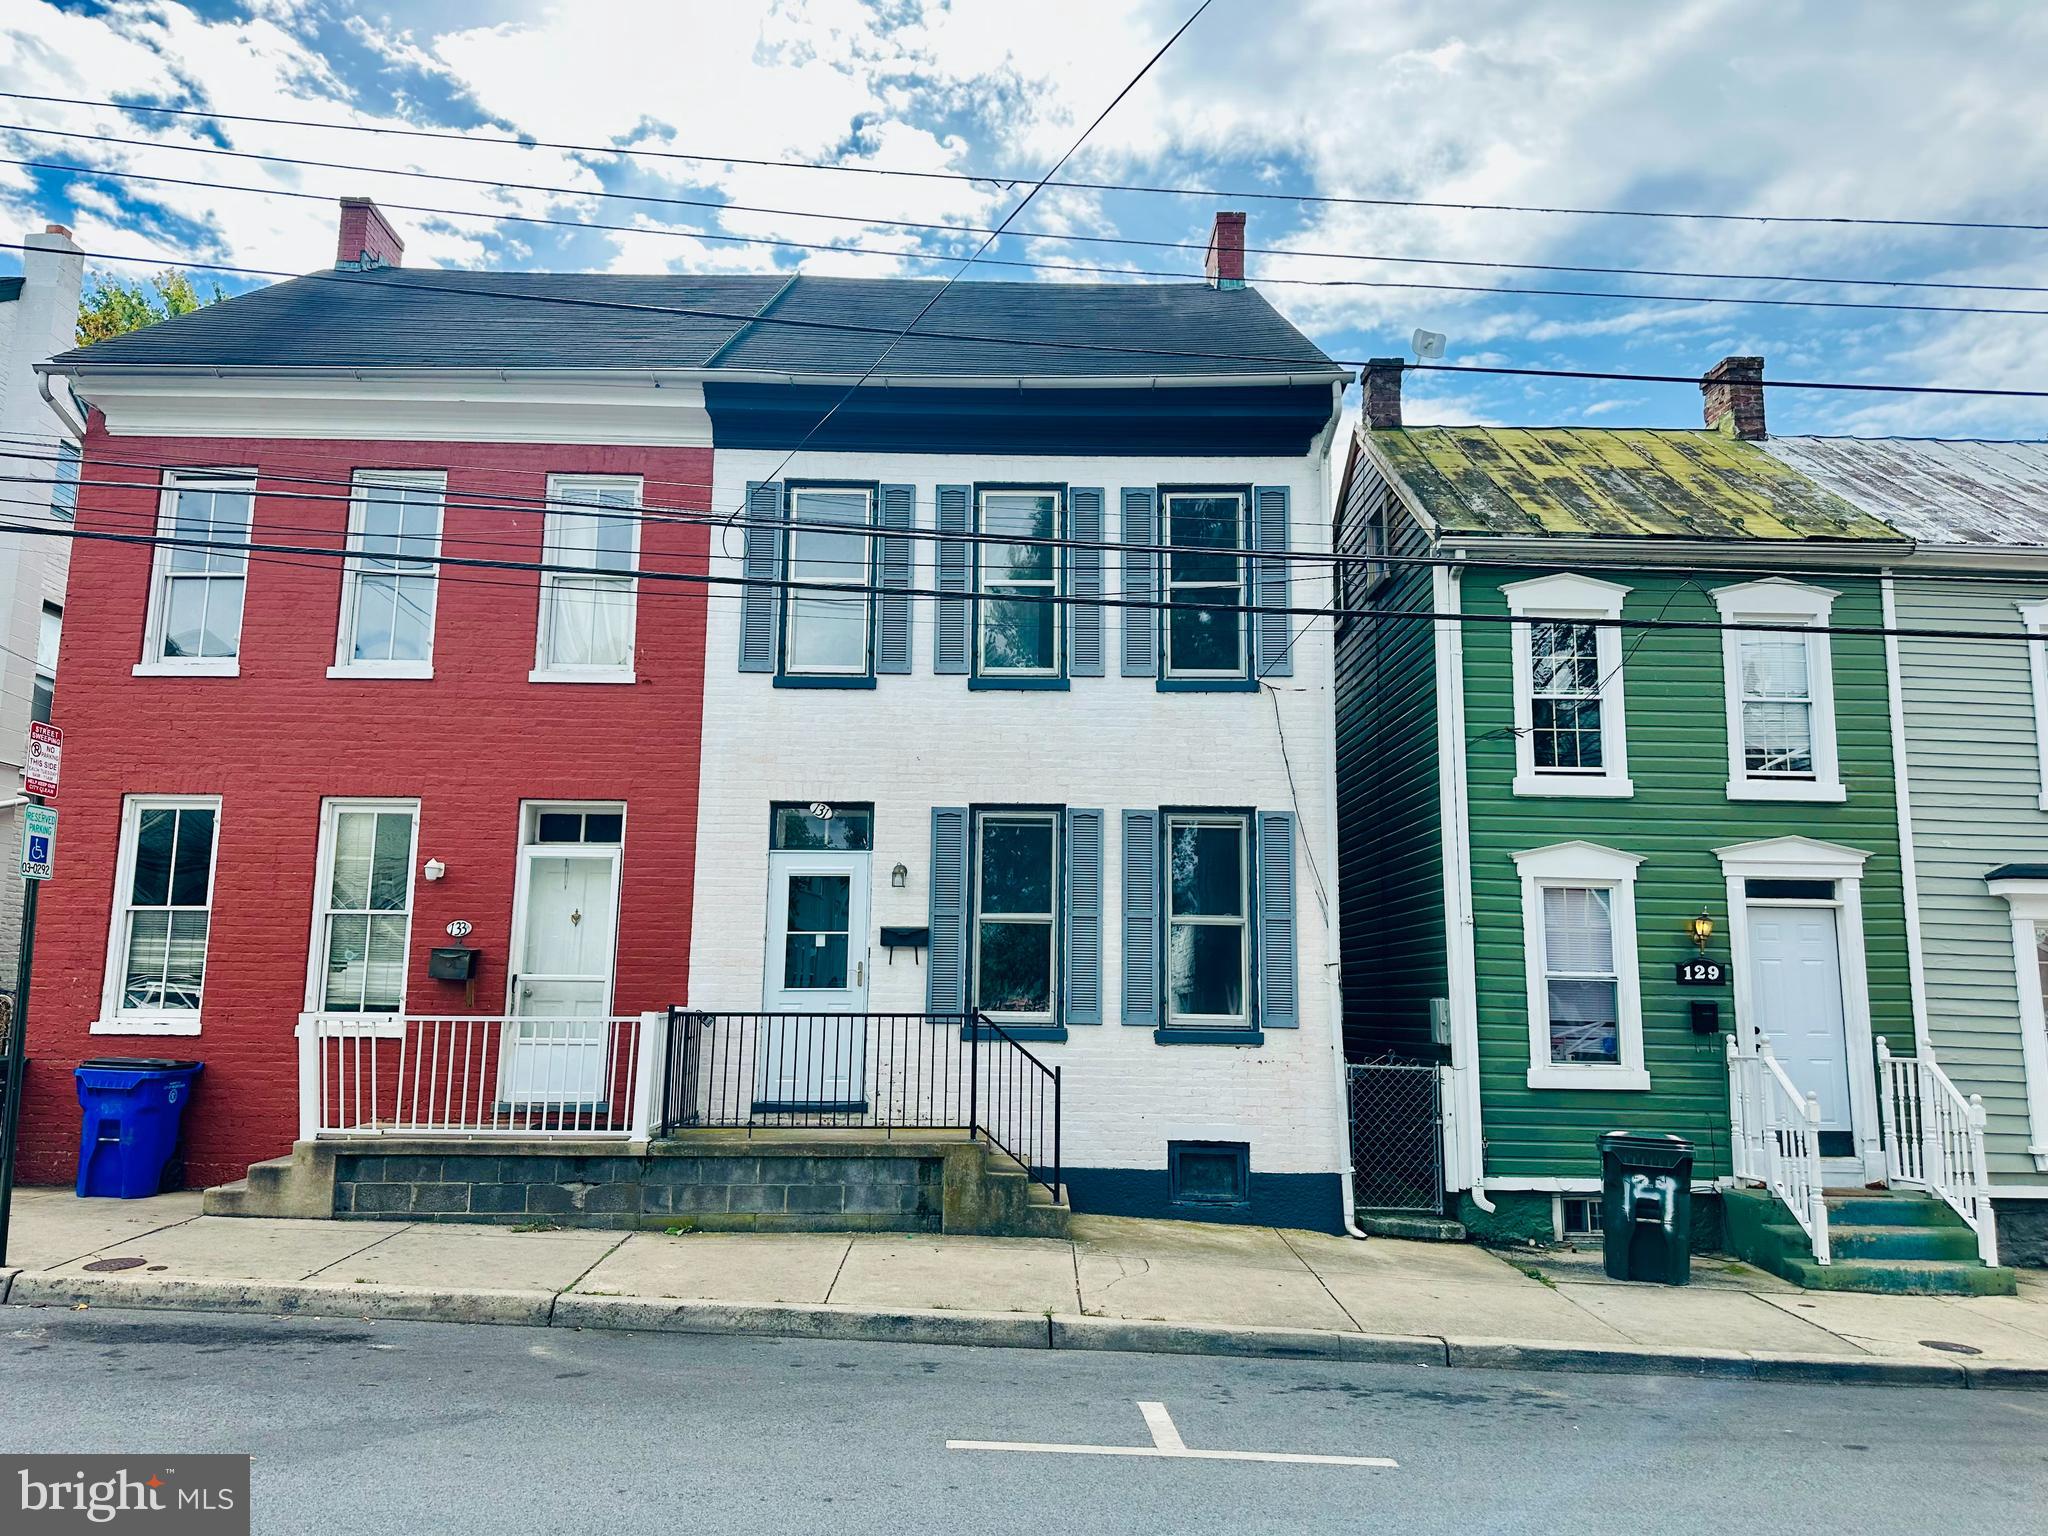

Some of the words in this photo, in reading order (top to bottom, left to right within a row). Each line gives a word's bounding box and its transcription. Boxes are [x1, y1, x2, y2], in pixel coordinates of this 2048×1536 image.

[32, 732, 60, 745] SWEEPING
[35, 726, 58, 738] STREET
[46, 745, 55, 753] NO
[30, 758, 43, 767] THIS
[44, 761, 57, 770] SIDE
[812, 803, 829, 818] 131
[27, 811, 55, 825] RESERVED
[29, 823, 51, 835] PARKING
[22, 862, 49, 875] 03-0292
[450, 921, 467, 935] 133
[1683, 965, 1719, 980] 129
